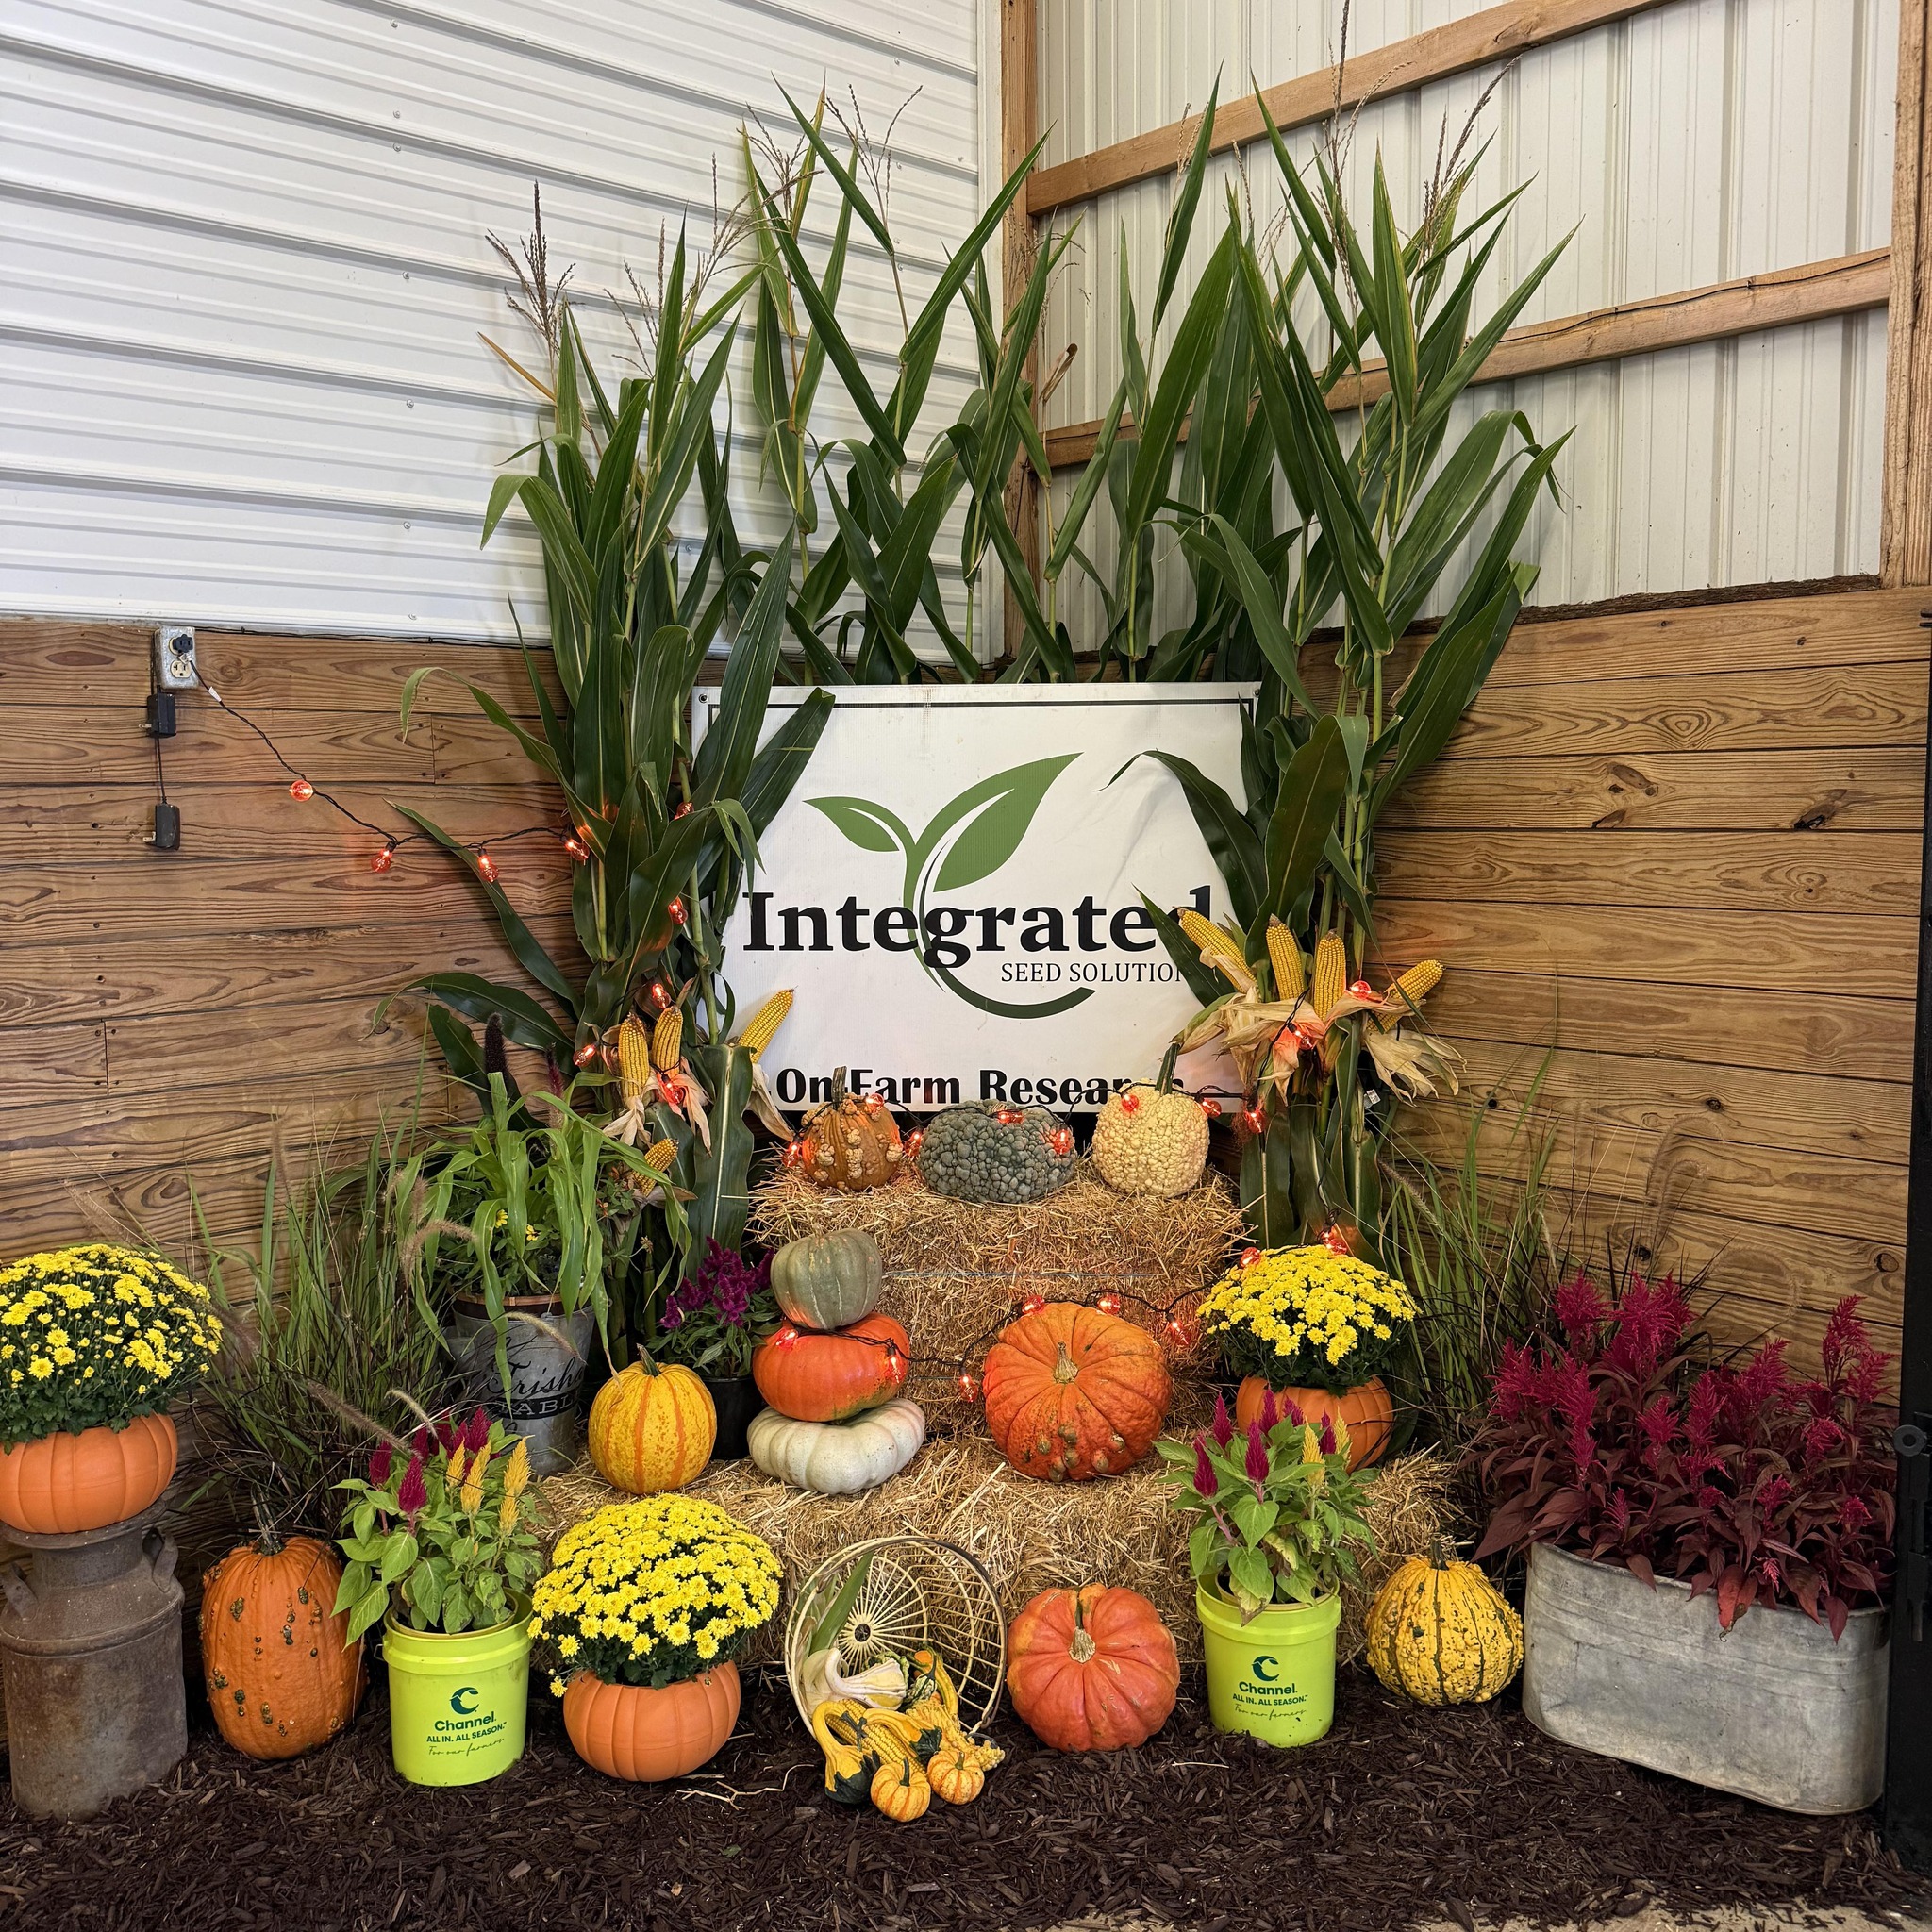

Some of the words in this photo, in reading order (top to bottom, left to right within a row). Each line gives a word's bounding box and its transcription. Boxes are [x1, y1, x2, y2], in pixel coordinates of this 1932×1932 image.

[1001, 963, 1062, 983] SEED
[1069, 963, 1181, 983] SOLUTIO
[1232, 1693, 1244, 1703] ALL
[1245, 1696, 1257, 1705] IN.
[426, 1735, 441, 1743] ALL
[456, 1733, 471, 1742] ALL
